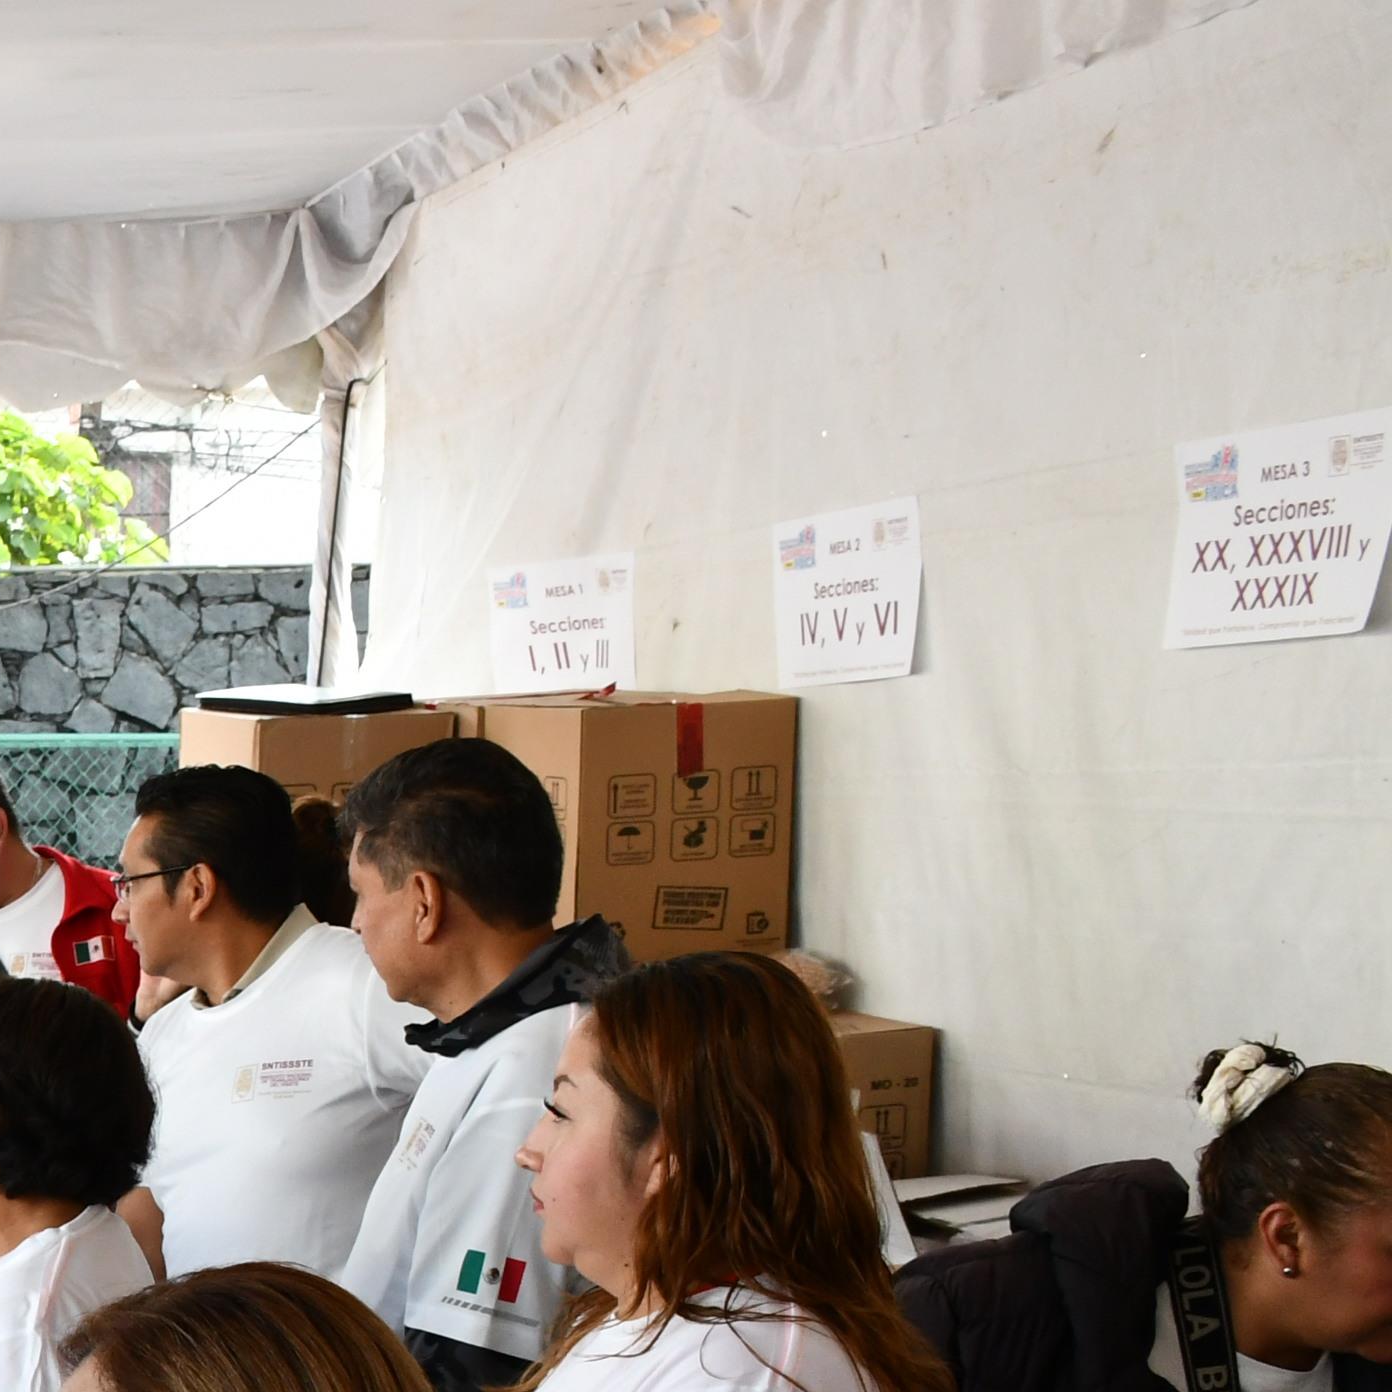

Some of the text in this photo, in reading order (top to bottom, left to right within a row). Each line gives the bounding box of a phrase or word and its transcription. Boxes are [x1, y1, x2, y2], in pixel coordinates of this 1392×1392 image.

[1261, 461, 1311, 483] MESA 3
[1233, 499, 1336, 527] Secciones:
[829, 538, 861, 555] MESA 2
[1191, 523, 1371, 574] XX, XXXVIII y
[545, 585, 575, 599] MESA
[814, 578, 880, 600] Secciones:
[1230, 572, 1319, 612] XXXIX
[800, 600, 899, 648] IV, V y VI
[553, 641, 571, 670] II
[580, 654, 589, 673] y
[595, 639, 610, 669] III
[261, 1059, 314, 1071] SNTISSSTE
